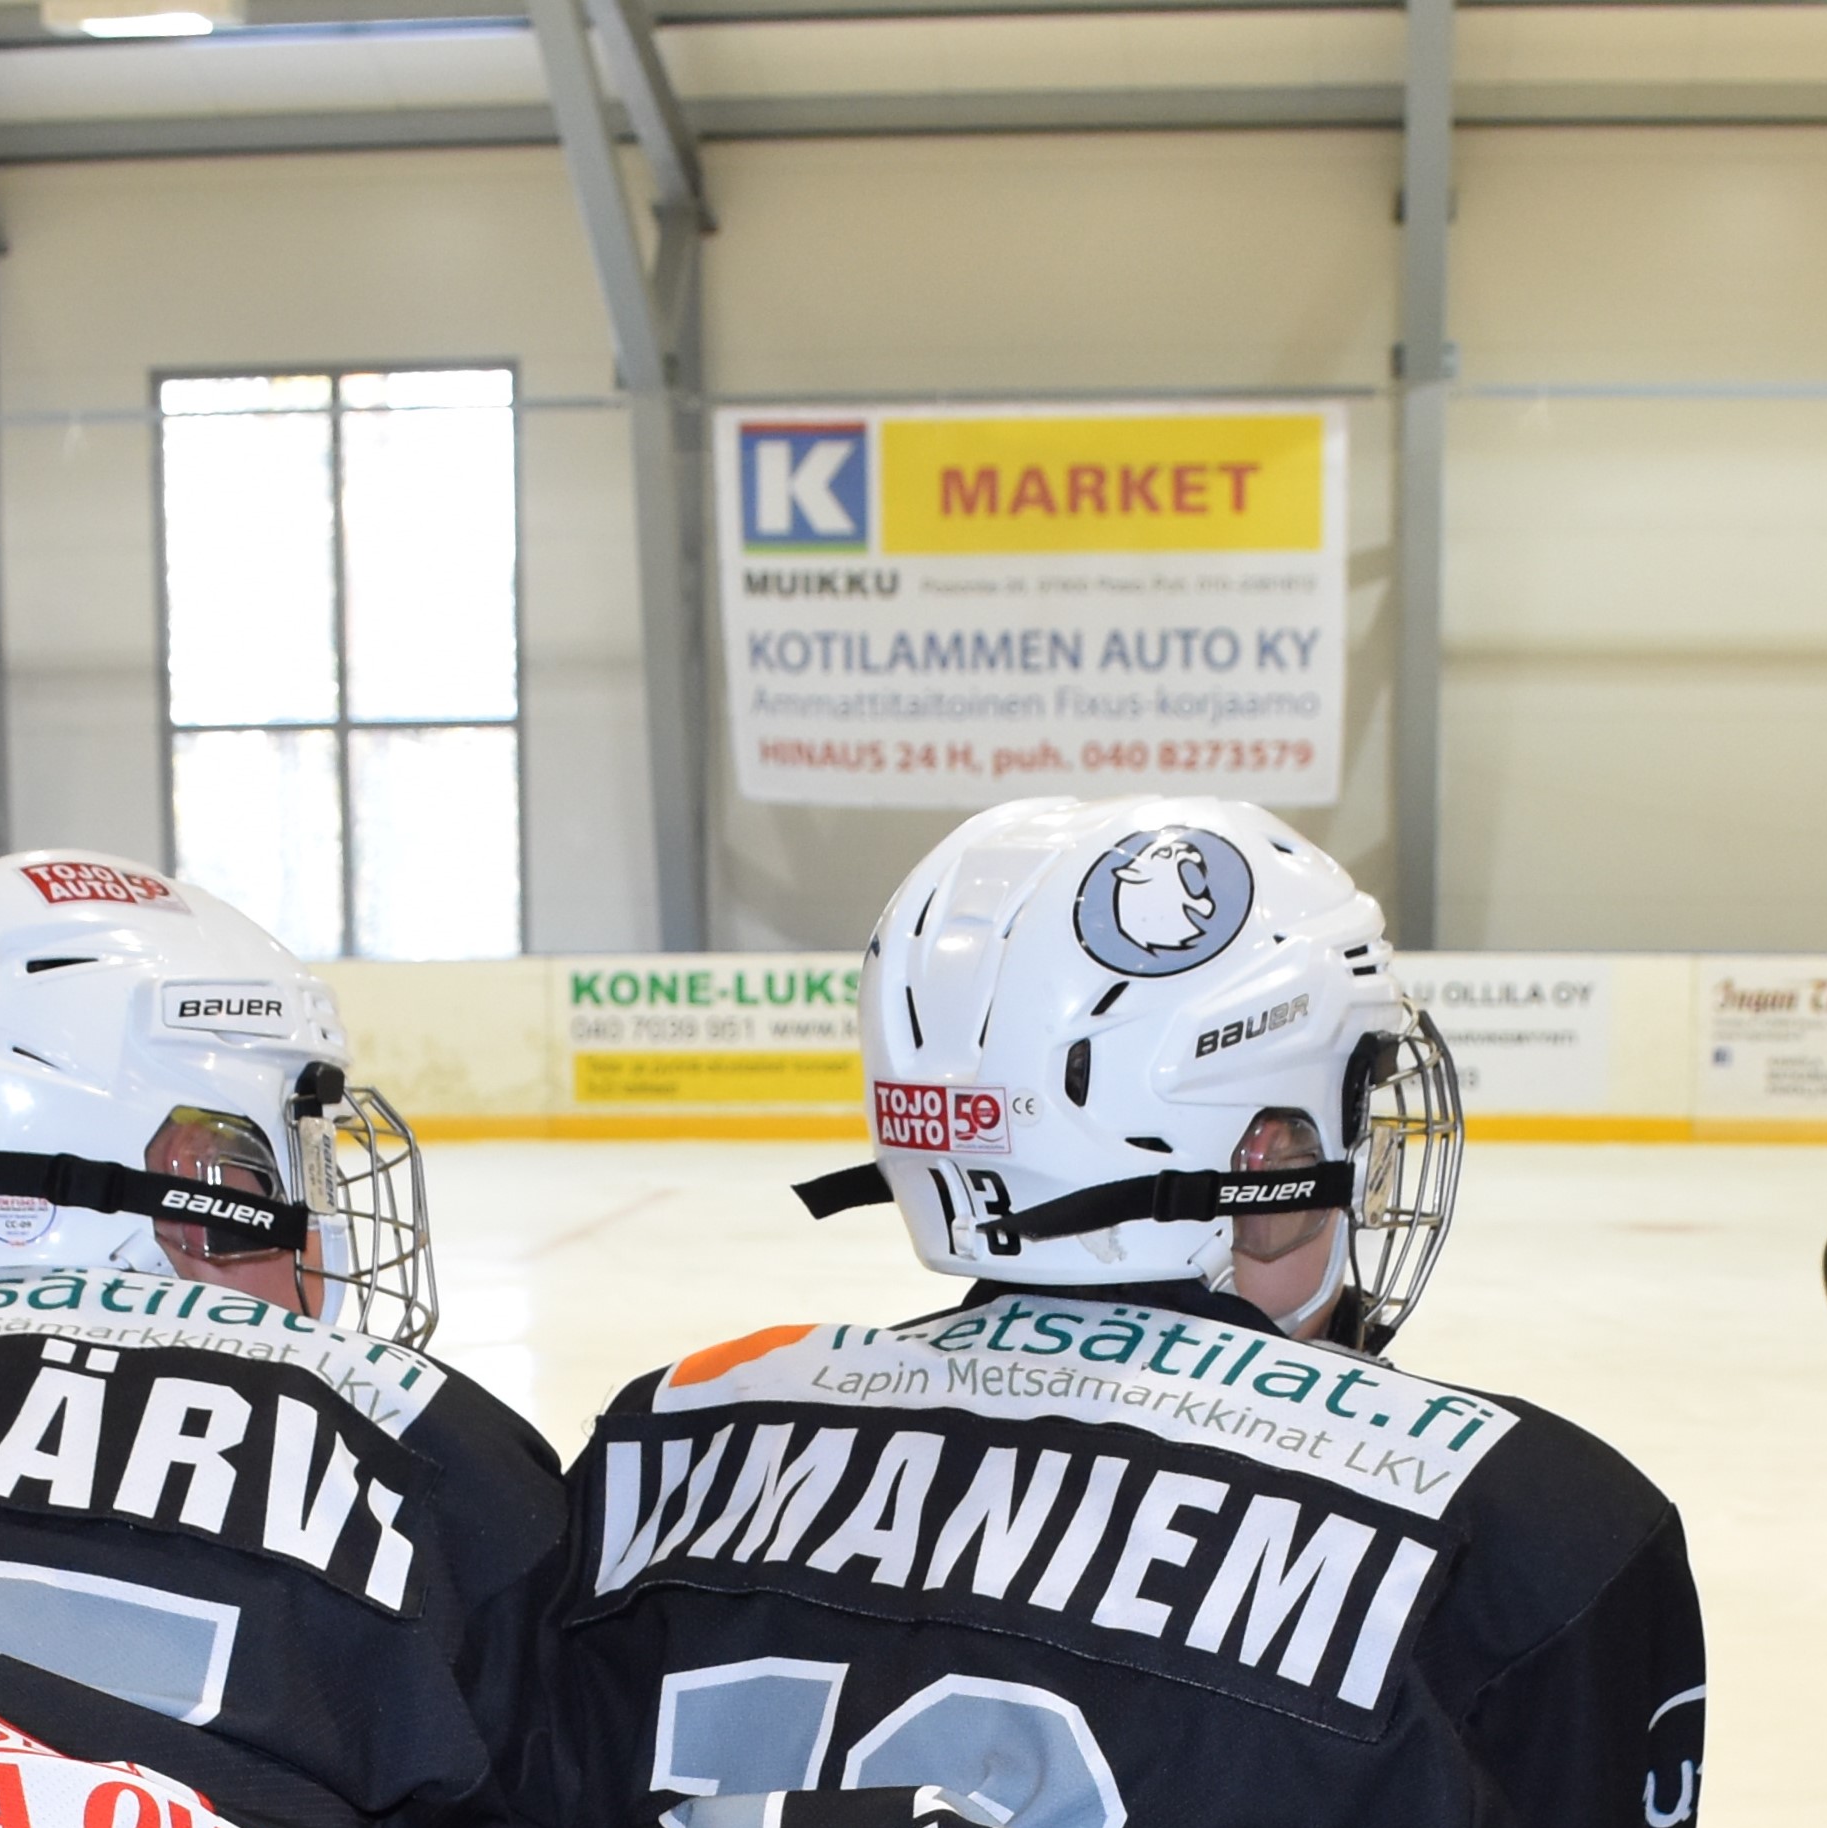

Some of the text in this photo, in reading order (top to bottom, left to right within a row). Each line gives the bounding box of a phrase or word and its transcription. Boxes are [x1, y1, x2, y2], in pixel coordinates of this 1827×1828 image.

[754, 439, 856, 536] K
[939, 463, 1261, 519] MARKET
[743, 569, 900, 599] MUIKKU
[747, 627, 1320, 675] KOTILAMMEN AUTO KY
[759, 737, 885, 769] HINAUS
[896, 741, 937, 769] 24
[992, 740, 1072, 776] puh.
[1081, 739, 1150, 770] 040
[29, 864, 115, 881] TOJO
[48, 879, 129, 900] AUTO
[178, 997, 284, 1018] BAUER
[1194, 992, 1311, 1060] BAUER
[877, 1086, 943, 1118] TOJO
[881, 1115, 945, 1146] AUTO
[161, 1188, 276, 1230] BAUER
[812, 1356, 1451, 1497] Lapin Metsämarkkinat LKV
